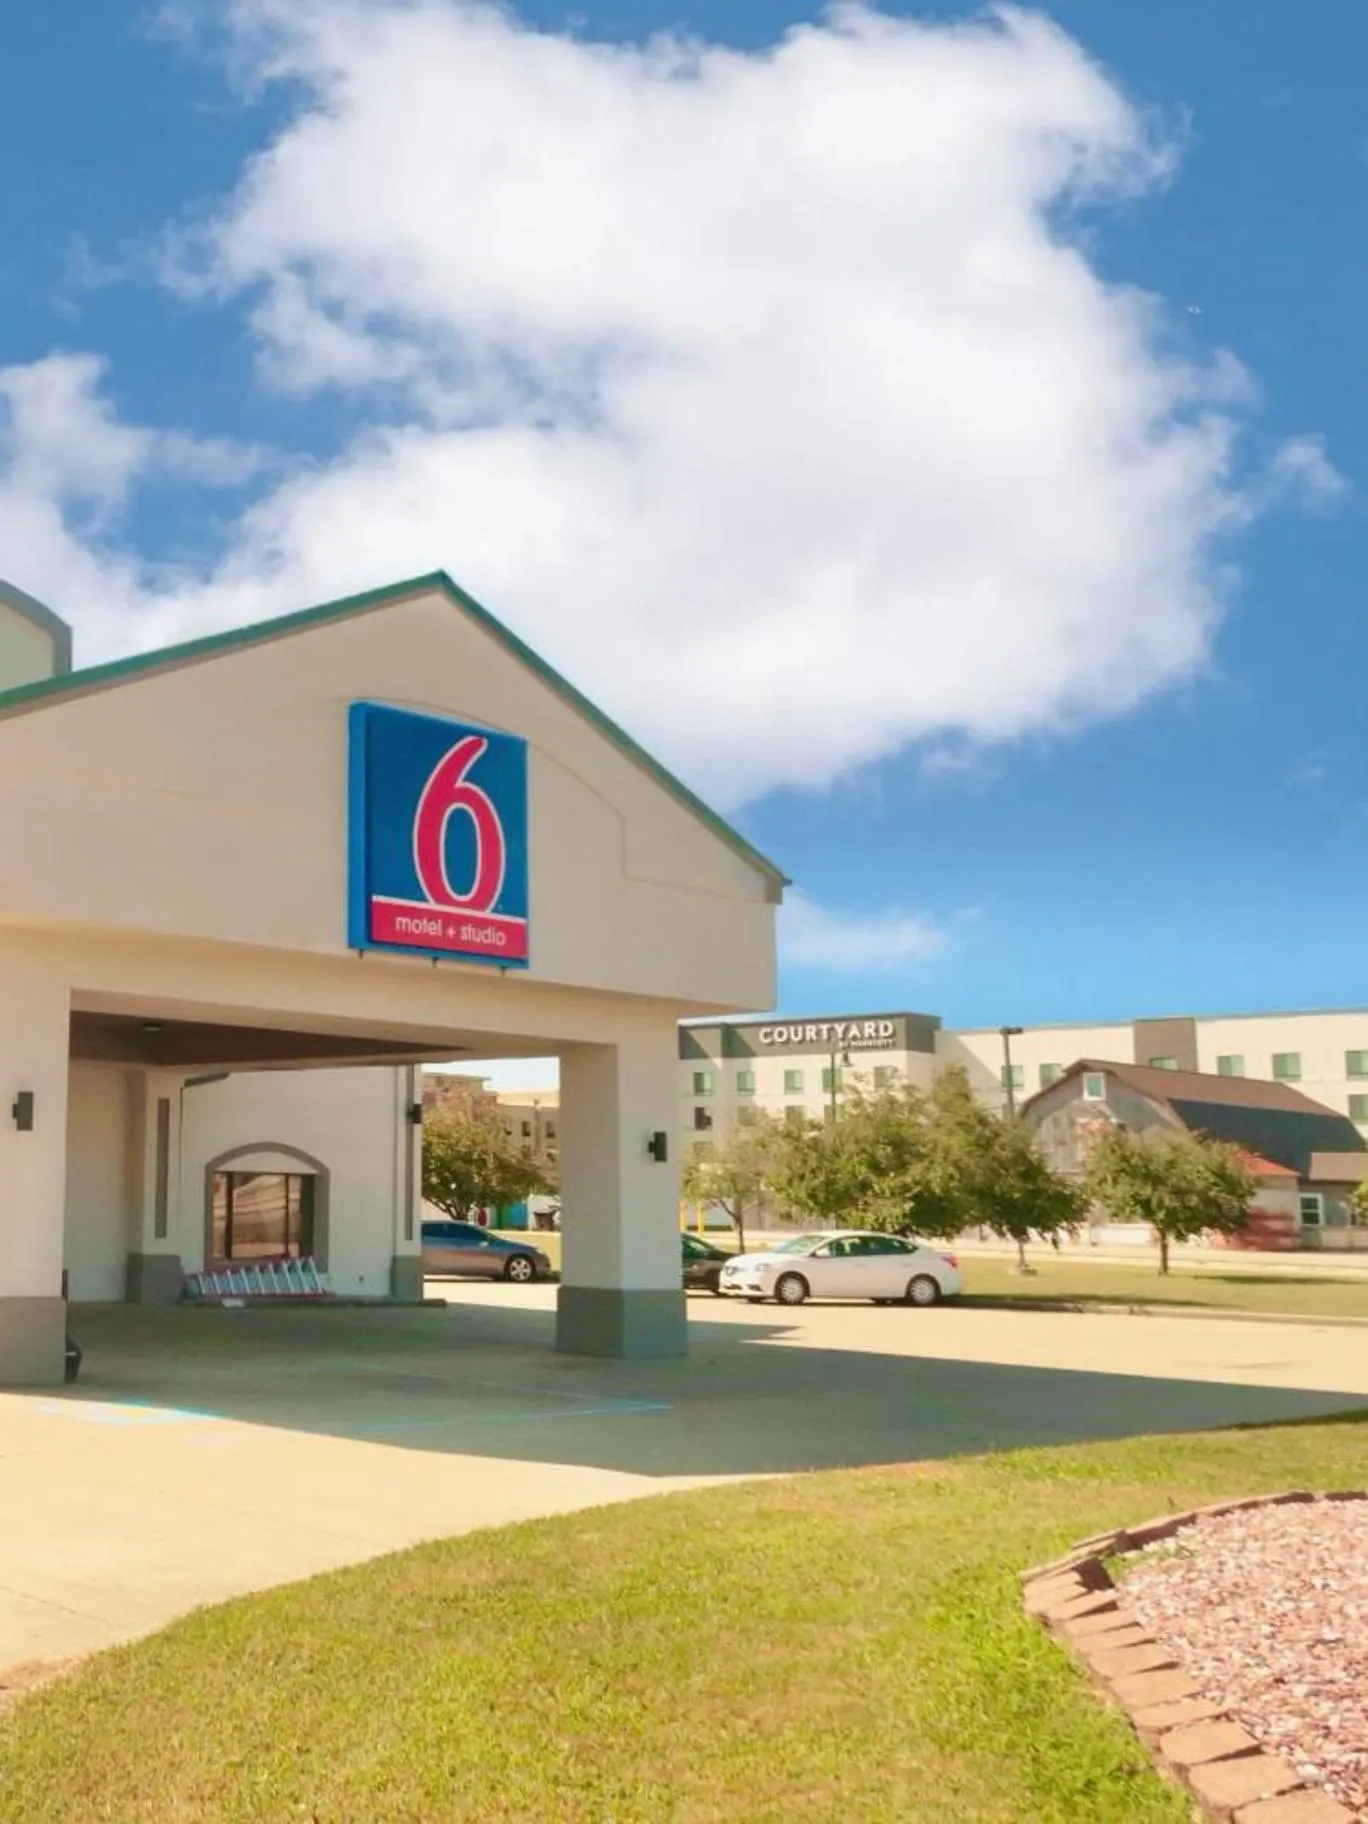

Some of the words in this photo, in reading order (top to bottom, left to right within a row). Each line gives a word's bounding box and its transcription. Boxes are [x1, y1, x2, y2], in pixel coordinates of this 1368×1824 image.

[413, 735, 506, 914] 6
[395, 916, 443, 937] motel
[460, 924, 507, 946] studio
[759, 1020, 894, 1043] COURTYARD
